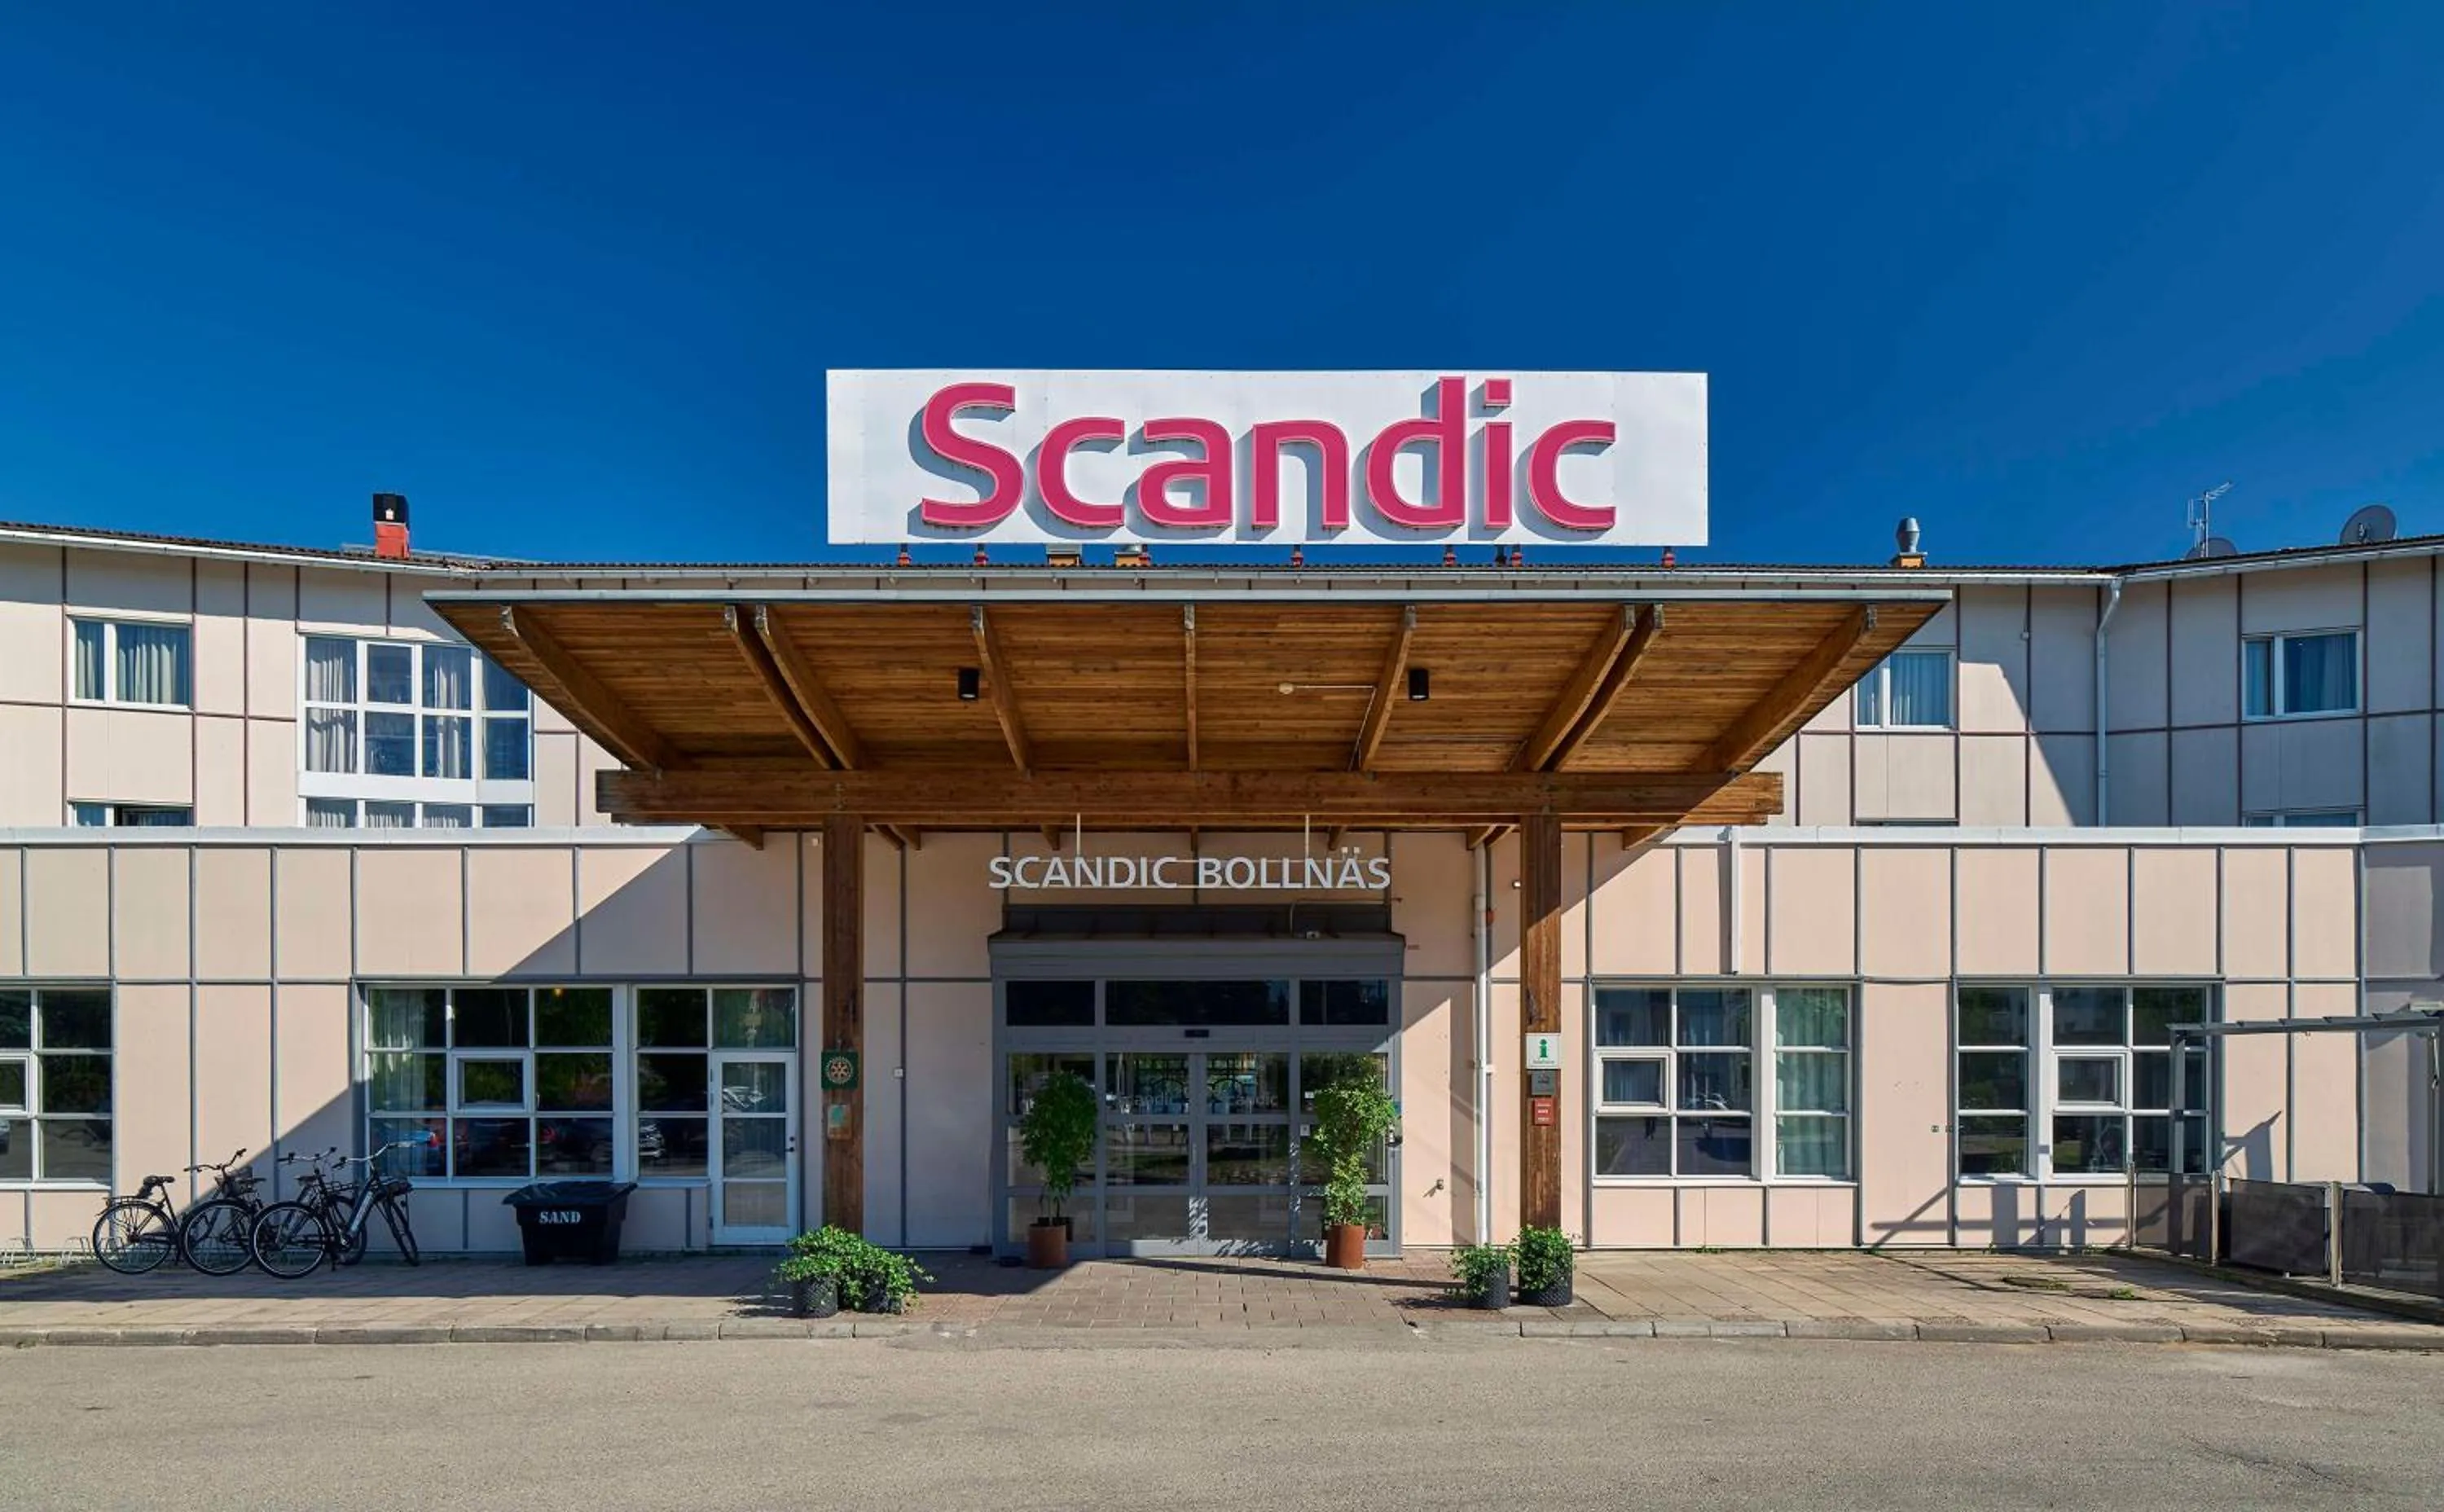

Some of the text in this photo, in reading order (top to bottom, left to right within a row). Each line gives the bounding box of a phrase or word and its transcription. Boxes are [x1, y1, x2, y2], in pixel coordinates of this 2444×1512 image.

[921, 376, 1616, 530] Scandic
[988, 846, 1391, 890] SCANDIC BOLLNÄS
[538, 1211, 582, 1224] SAND
